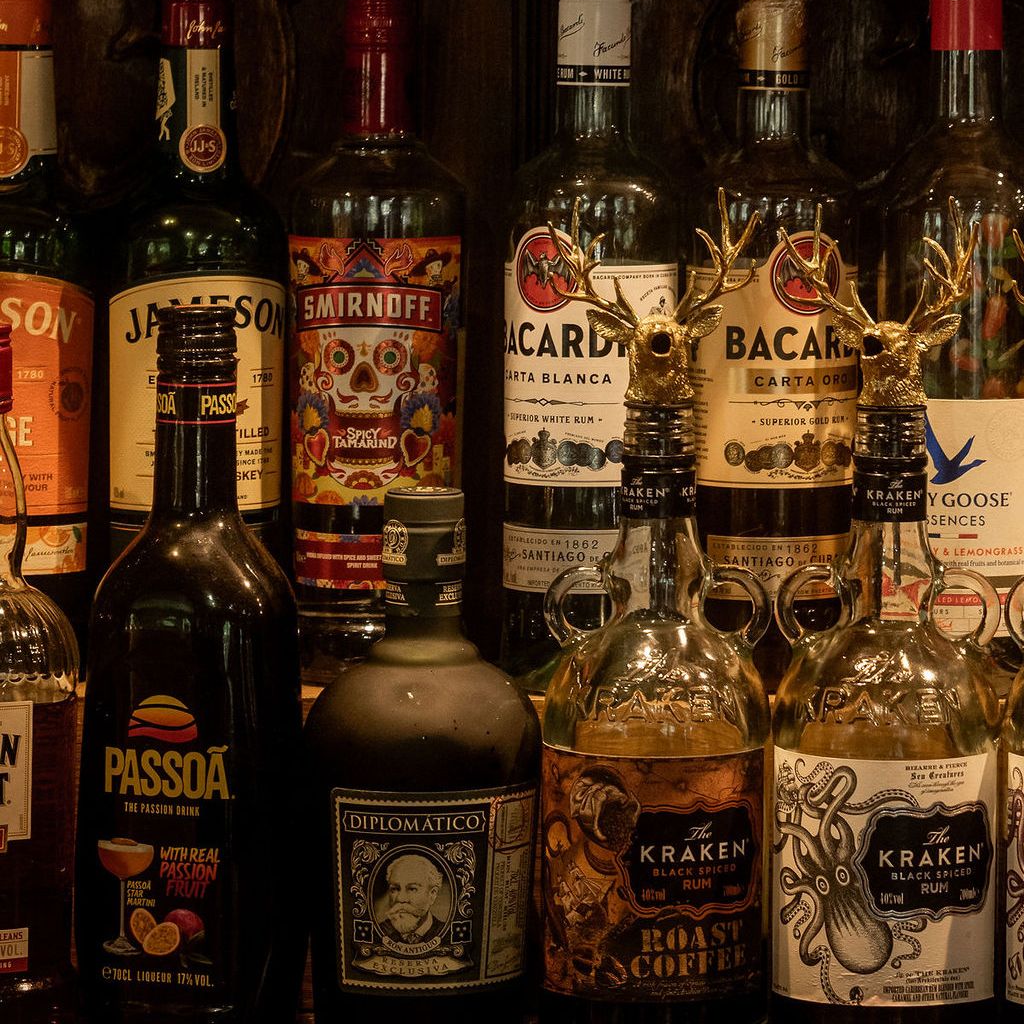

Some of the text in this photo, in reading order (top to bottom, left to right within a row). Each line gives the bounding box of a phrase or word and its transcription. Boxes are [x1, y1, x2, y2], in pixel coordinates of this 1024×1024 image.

[594, 69, 622, 80] WHITE
[775, 75, 798, 85] GOLD
[304, 291, 432, 322] SMIRNOFF
[126, 295, 284, 344] JASON
[542, 373, 612, 385] BLANCA
[755, 374, 848, 387] CARTA ORO
[542, 414, 594, 424] WHITE RUM
[760, 417, 806, 426] SUPERIOR
[347, 427, 380, 441] SPICY
[332, 436, 398, 450] TAMARIND
[867, 490, 921, 501] KRAKEN
[942, 492, 1009, 507] GOOSE
[565, 540, 599, 550] 1862
[787, 544, 818, 554] 1862
[954, 546, 1024, 556] LEMONGRASS
[522, 550, 585, 563] SANTIAGO
[724, 555, 795, 567] SANTIAGO
[105, 745, 230, 800] PASSOÃ
[140, 803, 200, 817] PASSION DRINK
[350, 814, 480, 833] DIPLOMÁTICO
[640, 839, 745, 863] KRAKEN
[879, 843, 980, 868] KRAKEN
[652, 863, 737, 877] BLACK SPICED
[891, 867, 972, 881] BLACK SPICED
[682, 879, 711, 890] RUM
[921, 882, 948, 894] RUM
[127, 889, 143, 898] STAR
[127, 897, 156, 907] MARTINI
[641, 920, 743, 953] ROAST
[382, 958, 438, 967] RESERVA
[630, 943, 746, 978] COFFEE
[372, 963, 450, 975] EXCLUSIVA
[137, 970, 172, 984] LIQUEUR
